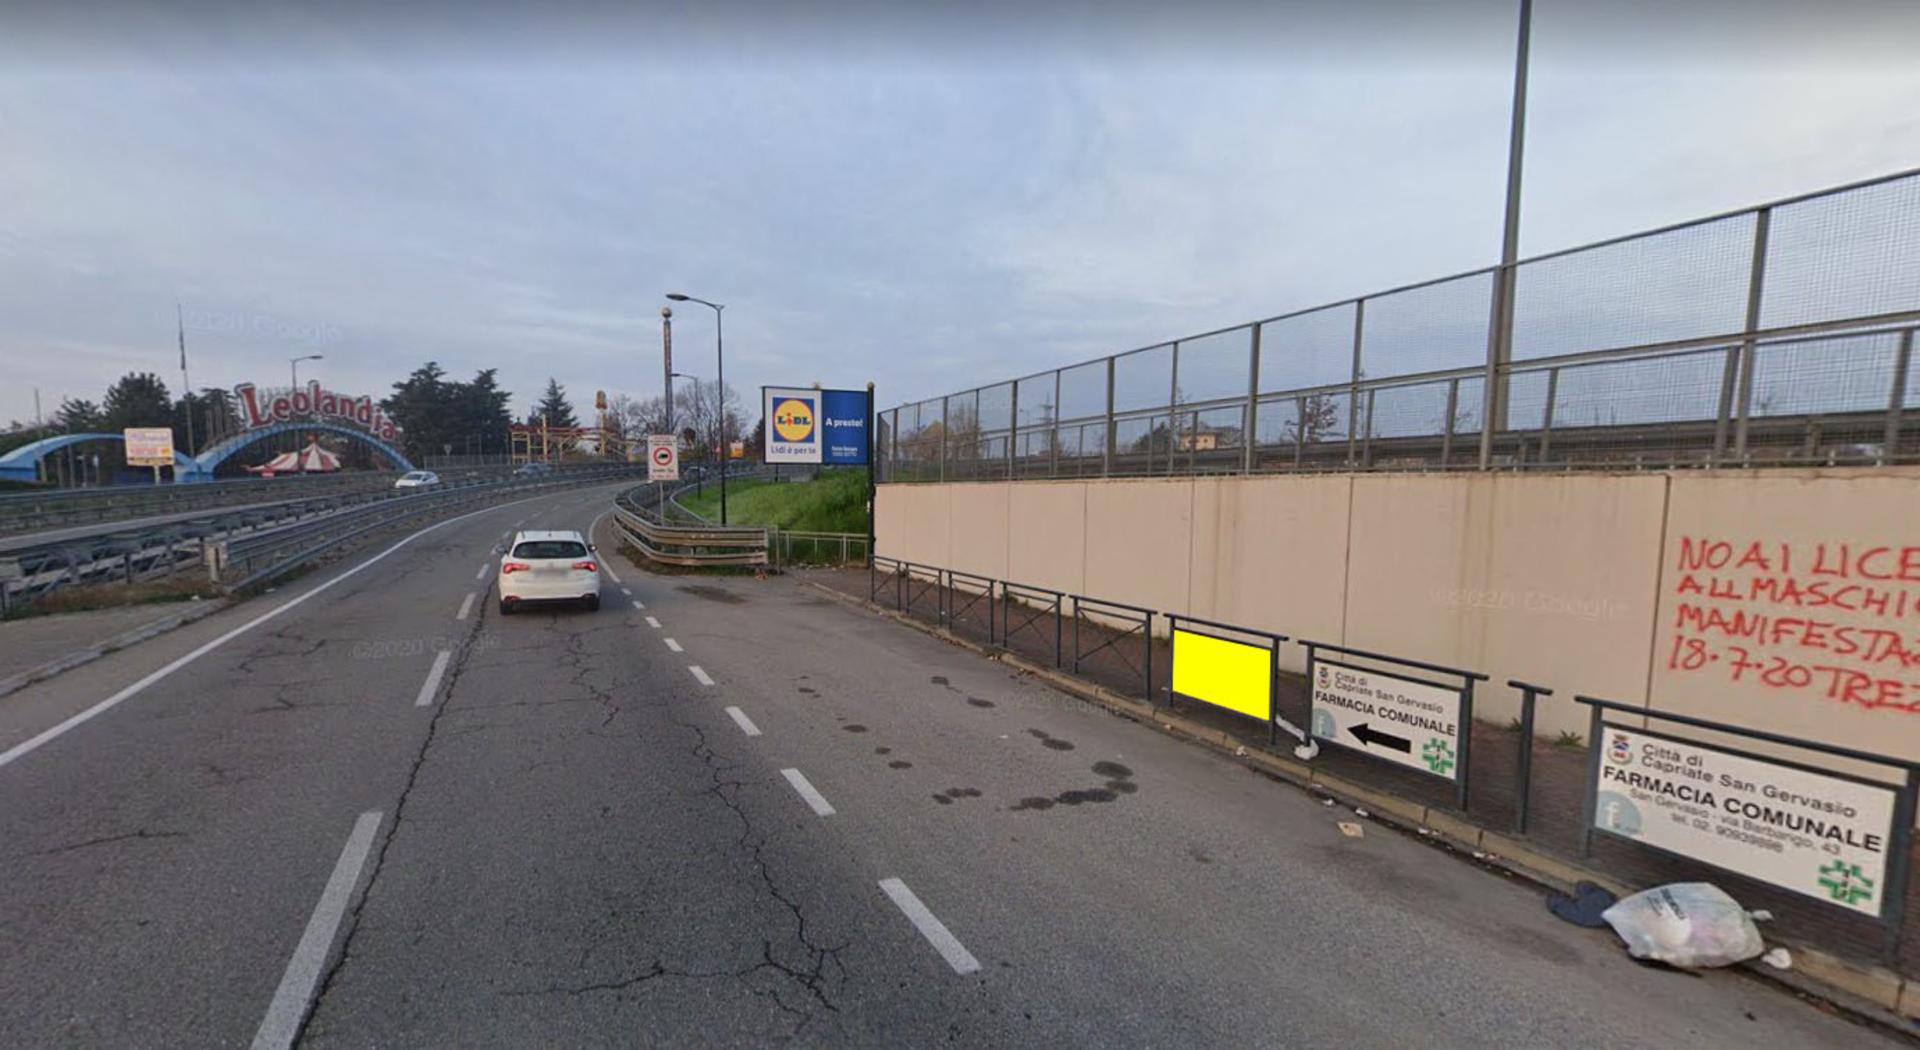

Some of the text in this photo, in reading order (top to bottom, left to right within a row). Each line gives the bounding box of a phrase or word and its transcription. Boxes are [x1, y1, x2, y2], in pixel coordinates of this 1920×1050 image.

[234, 380, 397, 441] Leolandia
[825, 417, 864, 428] A presto!
[770, 445, 785, 454] Lidl
[794, 447, 807, 456] per
[1678, 536, 1732, 571] NO
[1750, 577, 1920, 618] MASCHI
[1676, 603, 1920, 666] MANIFESTA
[1335, 679, 1444, 714] Capriate San Gervasio
[1358, 676, 1368, 686] di
[1315, 690, 1456, 737] FARMACIA COMUNALE
[1687, 755, 1703, 767] di
[1630, 788, 1653, 801] San
[1641, 754, 1857, 818] Capriate San Gervasio
[1603, 765, 1882, 853] FARMACIA COMUNALE
